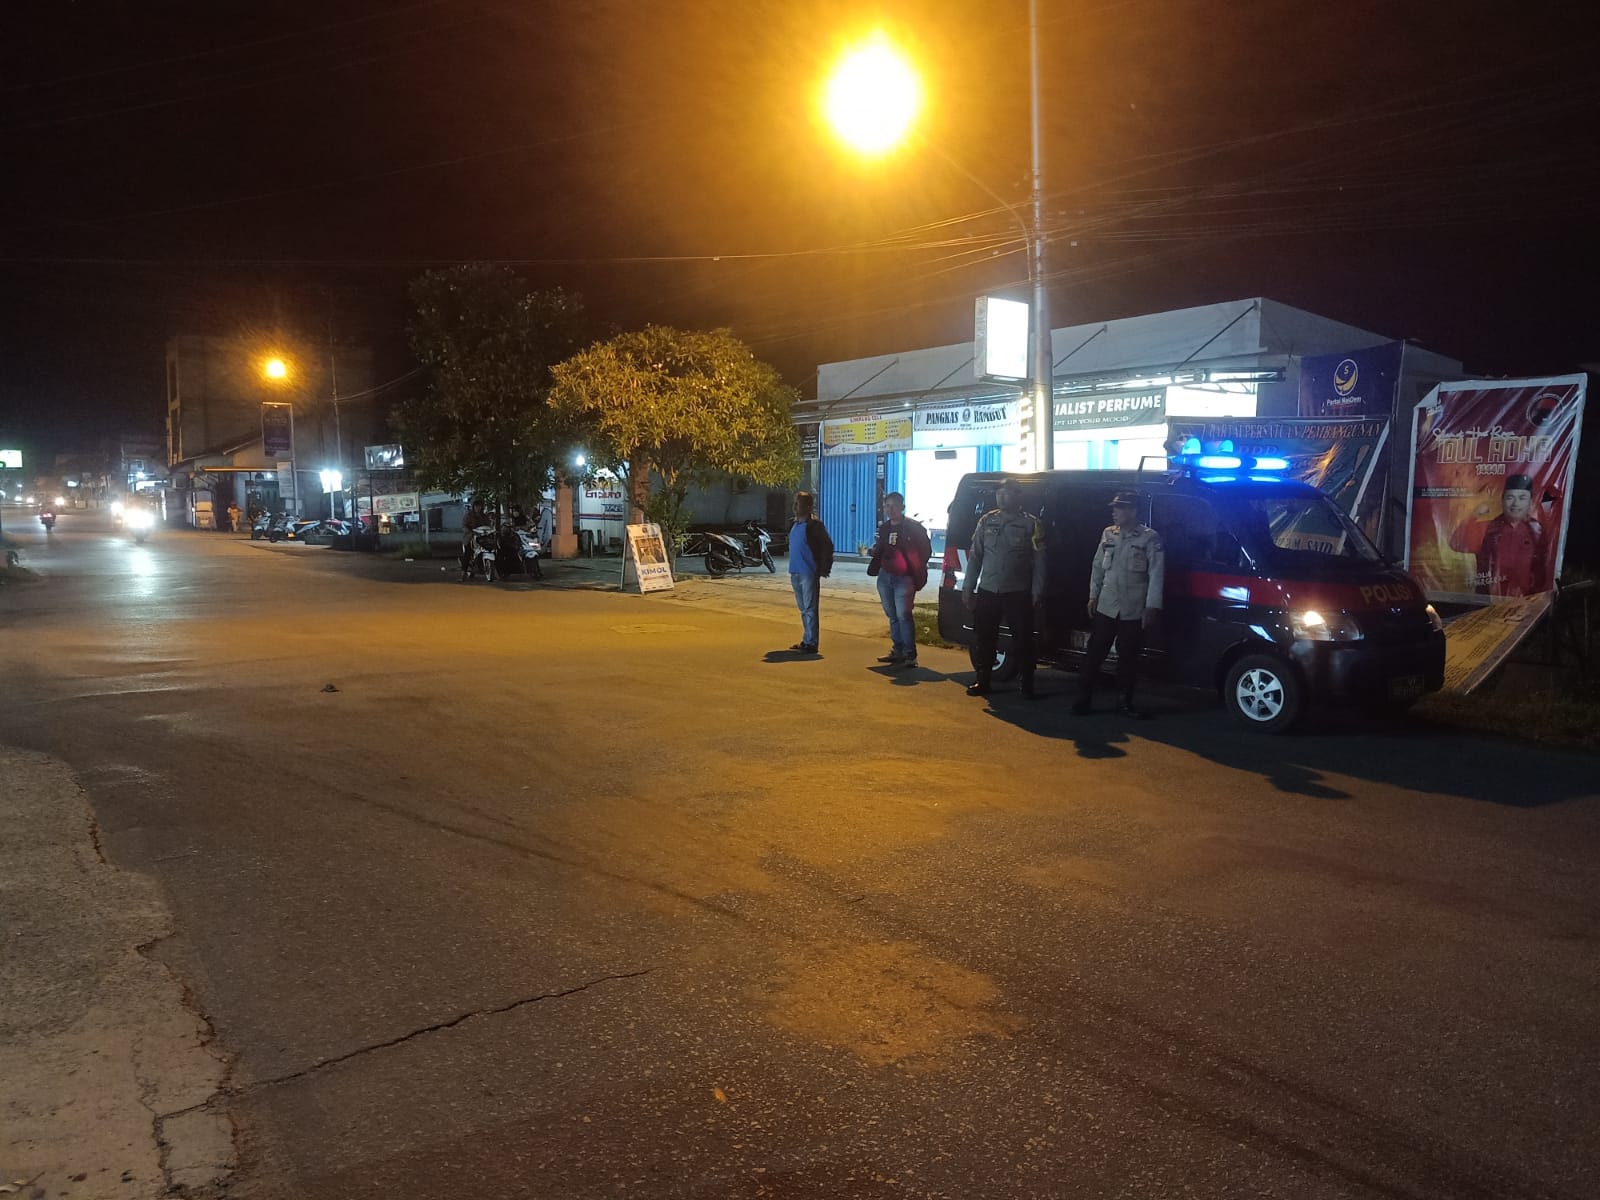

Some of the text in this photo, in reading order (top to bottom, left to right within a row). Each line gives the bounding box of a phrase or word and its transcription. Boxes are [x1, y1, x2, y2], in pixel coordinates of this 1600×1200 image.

[926, 406, 1008, 425] PANGKAS RAMBUT
[1053, 395, 1162, 416] IALIST PERFUME
[1078, 417, 1101, 425] YOUR
[1102, 415, 1129, 423] MOOD
[1301, 423, 1381, 439] PEMBANGUNAN
[1436, 435, 1554, 464] IDUL ADHA
[1359, 584, 1415, 605] POLISI
